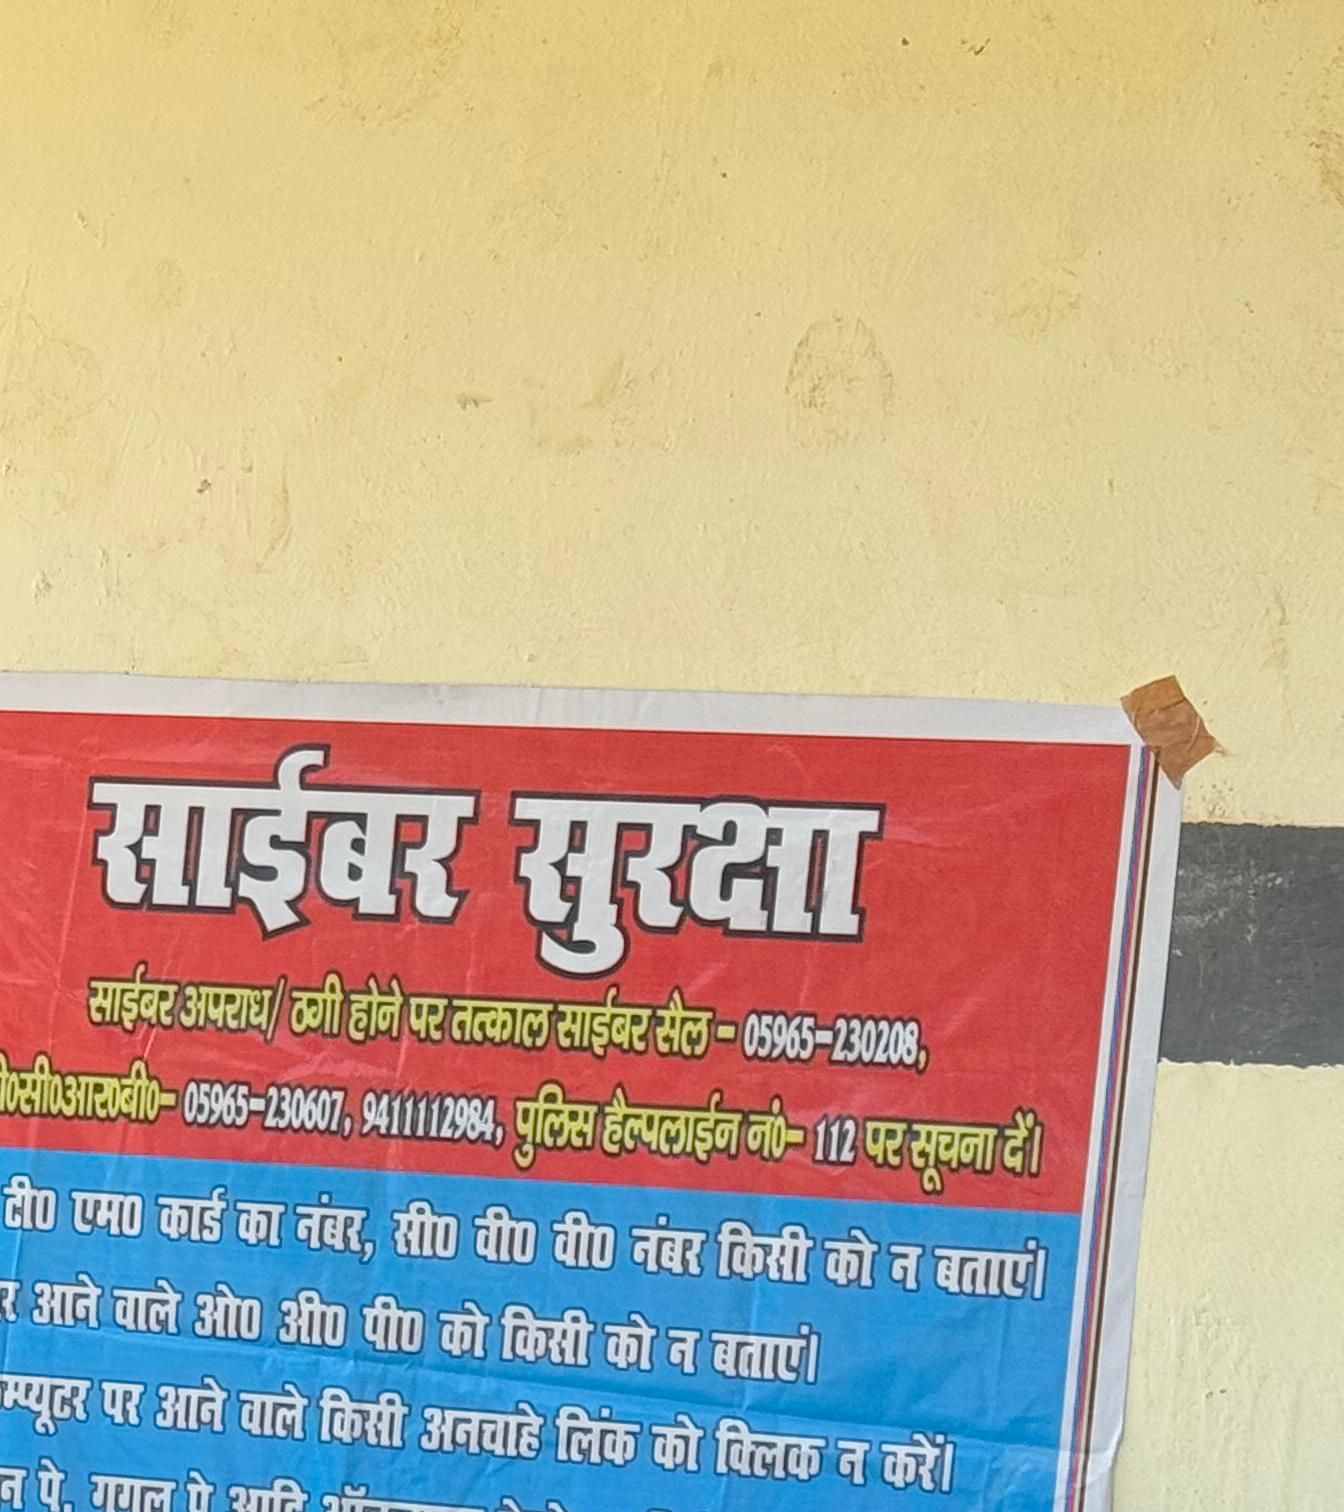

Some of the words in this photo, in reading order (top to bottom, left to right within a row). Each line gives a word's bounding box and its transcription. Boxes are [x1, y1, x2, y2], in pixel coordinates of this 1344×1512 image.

[89, 744, 479, 939] साईबर
[511, 793, 885, 977] सुरक्षा
[88, 964, 181, 1030] साईबर
[348, 977, 404, 1041] होने
[409, 995, 450, 1042] पर
[451, 999, 554, 1050] तत्काल
[556, 987, 653, 1056] साईबर
[655, 990, 713, 1056] सैल
[514, 1083, 602, 1168] पुलिस
[602, 1087, 743, 1161] हैल्पलाईन
[814, 1119, 856, 1162] 112
[865, 1120, 908, 1166] पर
[910, 1123, 999, 1191] सूचना
[157, 1187, 227, 1242] कार्ड
[236, 1202, 285, 1246] का
[631, 1216, 707, 1275] नंबर
[717, 1221, 814, 1282] किसी
[824, 1229, 878, 1287] को
[890, 1245, 923, 1290] न
[32, 1273, 102, 1328] आने
[112, 1279, 182, 1333] वाले
[439, 1302, 490, 1357] को
[500, 1305, 595, 1366] किसी
[604, 1313, 657, 1370] को
[668, 1329, 700, 1373] न
[101, 1381, 145, 1425] पर
[156, 1377, 228, 1432] आने
[239, 1383, 309, 1439] वाले
[319, 1387, 409, 1447] किसी
[420, 1402, 545, 1458] अनचाहे
[555, 1406, 641, 1465] लिंक
[651, 1414, 704, 1471] को
[715, 1418, 826, 1480] क्लिक
[837, 1440, 870, 1484] न
